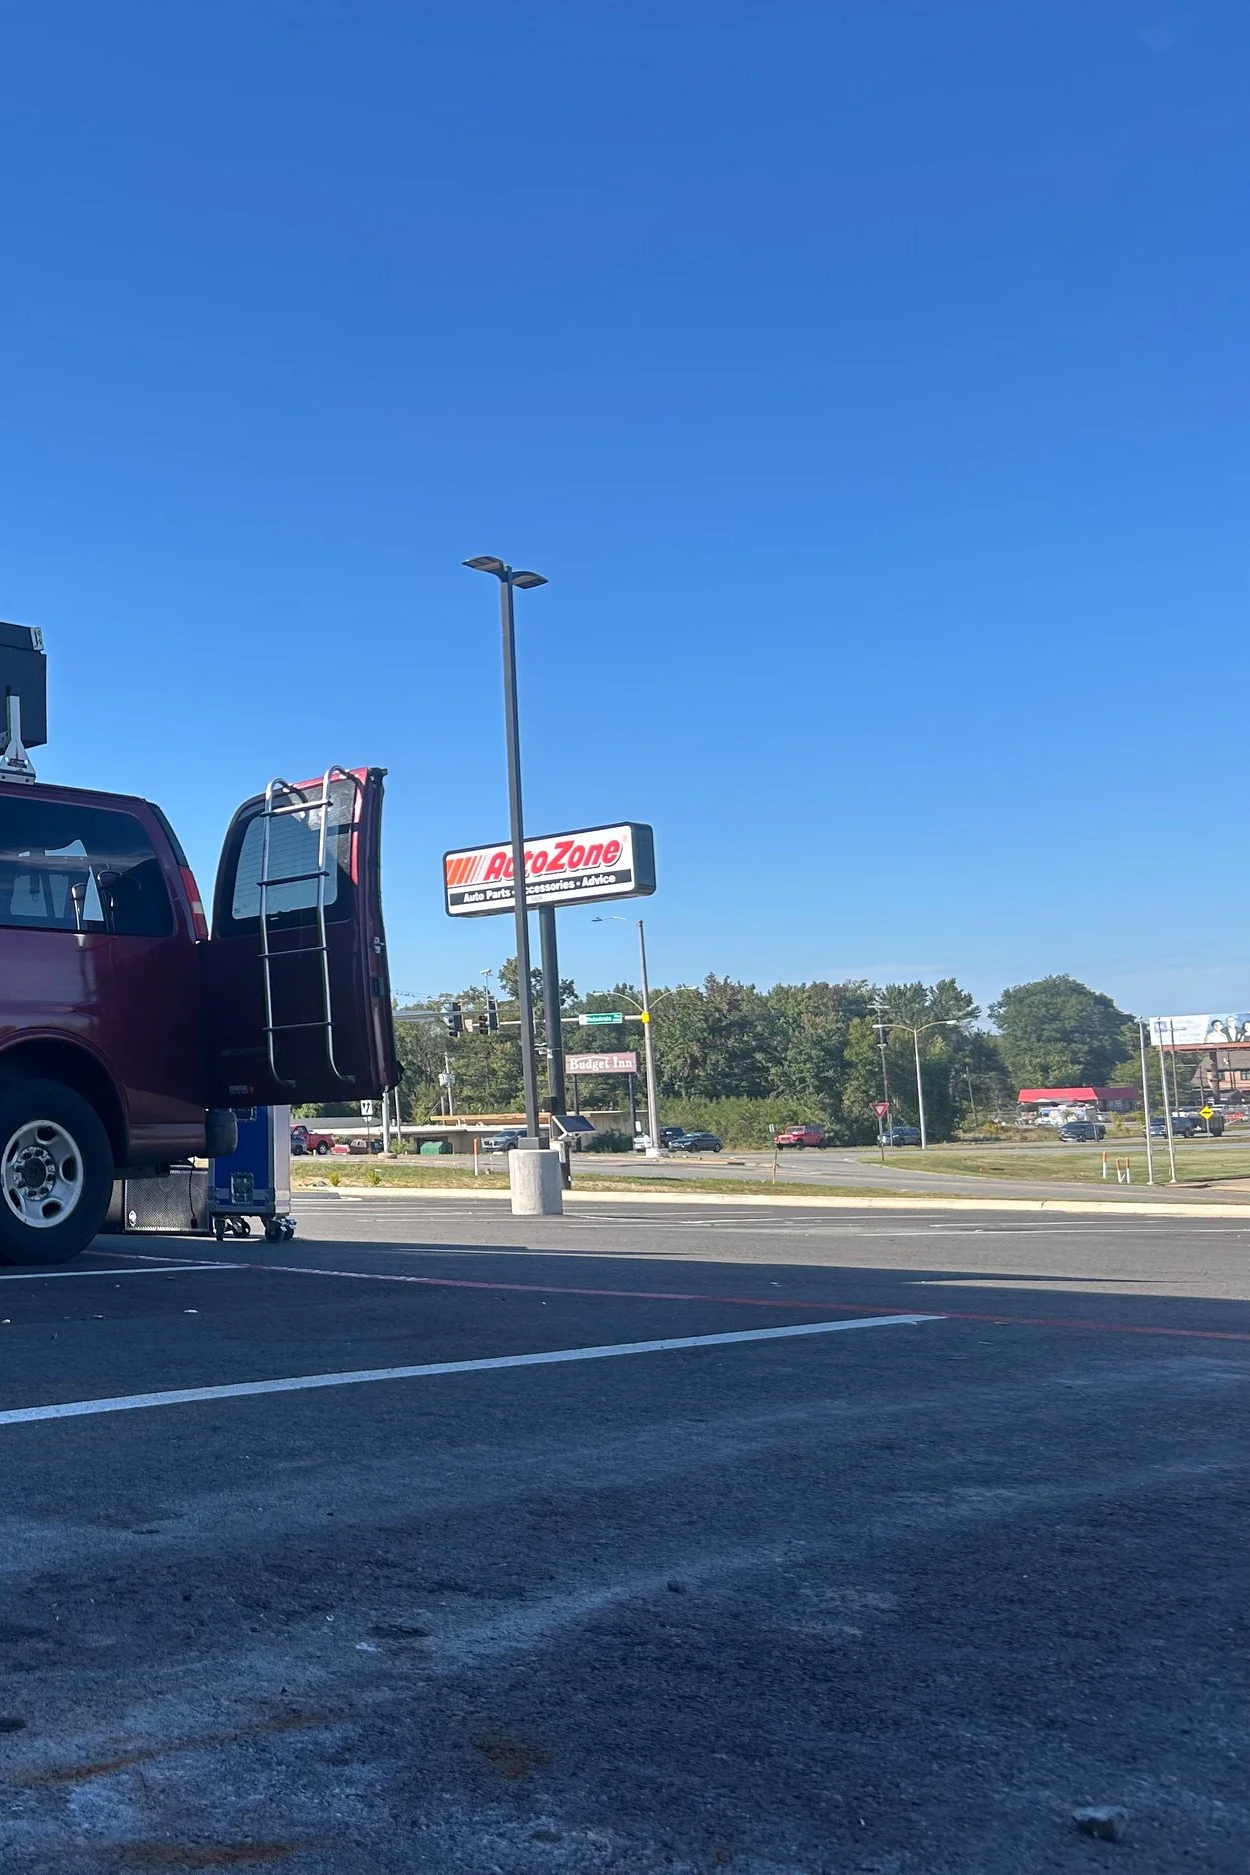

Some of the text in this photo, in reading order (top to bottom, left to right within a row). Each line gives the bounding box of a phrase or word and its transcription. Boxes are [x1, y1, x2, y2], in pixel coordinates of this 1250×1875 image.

[463, 891, 485, 903] Auto
[486, 888, 511, 900] Parts
[582, 874, 616, 887] Advice
[569, 1056, 632, 1071] Budget Inn
